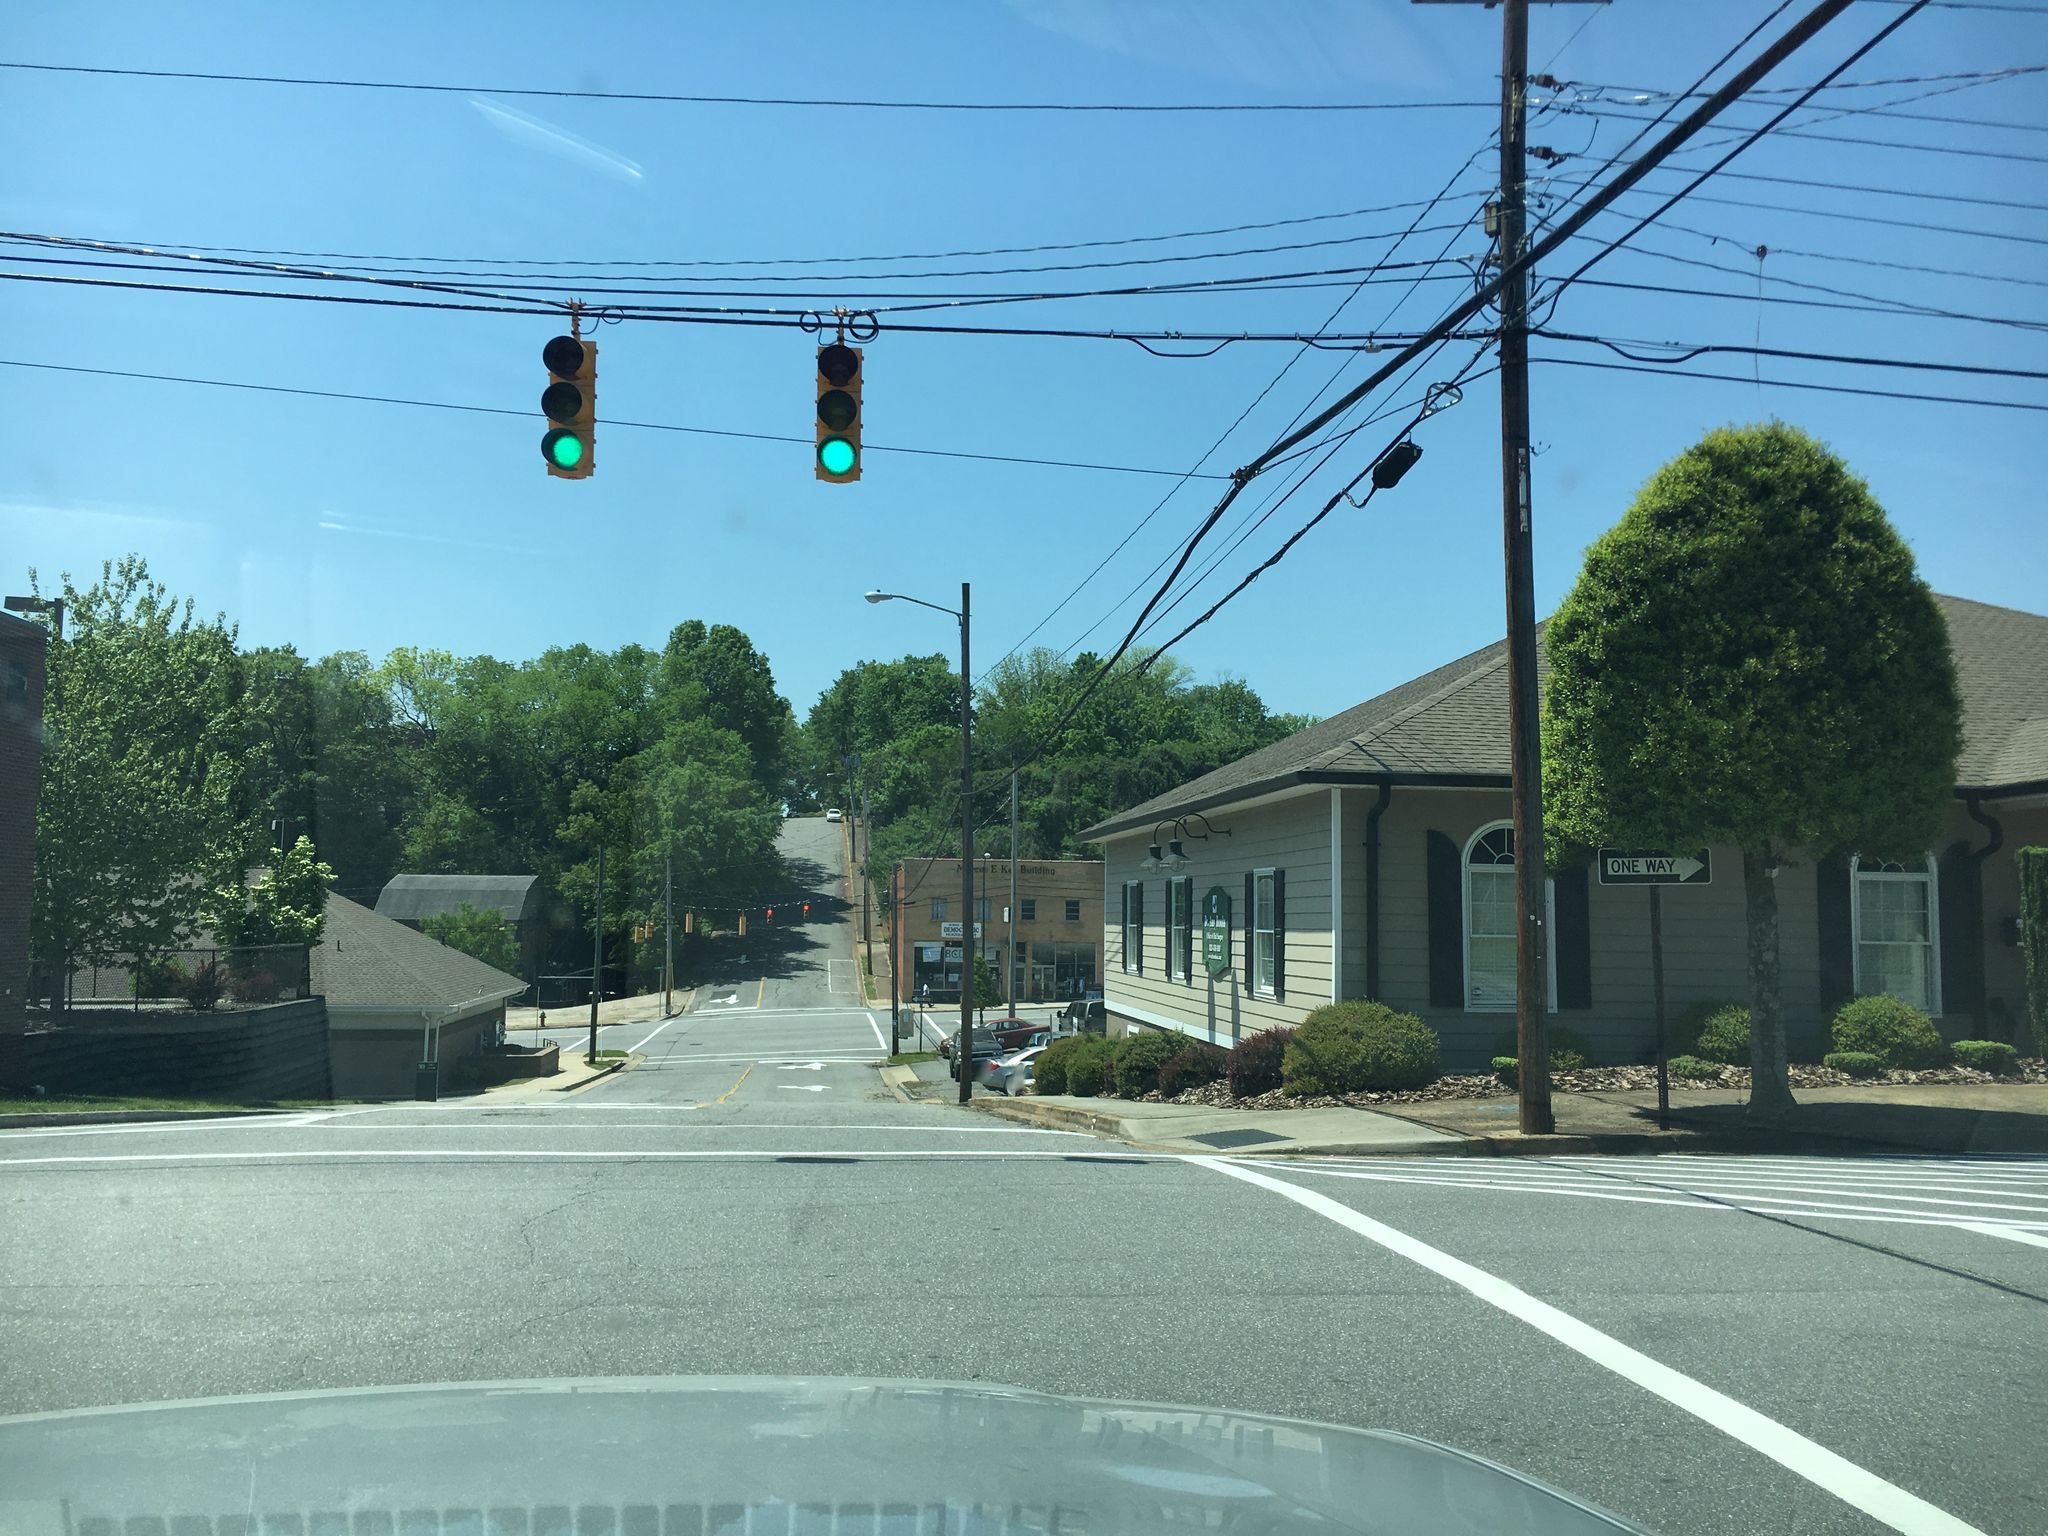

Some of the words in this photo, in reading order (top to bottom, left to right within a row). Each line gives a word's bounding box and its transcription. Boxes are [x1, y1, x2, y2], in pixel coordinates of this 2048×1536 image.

[1020, 864, 1056, 876] Building
[1611, 859, 1640, 873] ONE
[1645, 859, 1676, 873] WAY
